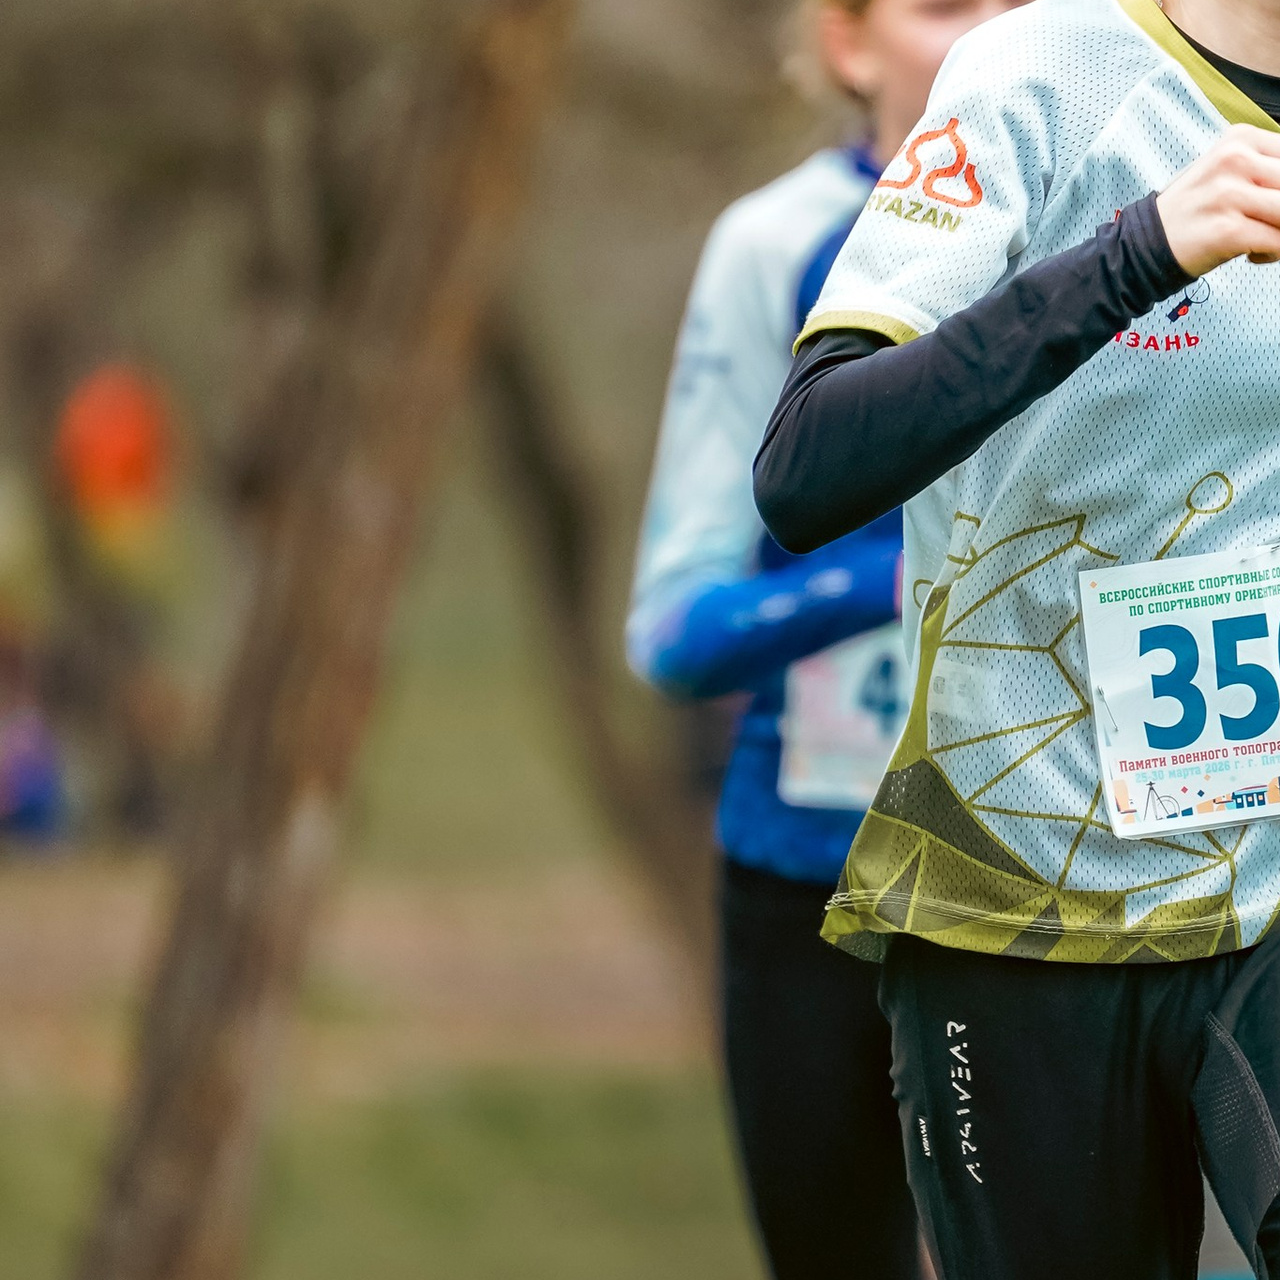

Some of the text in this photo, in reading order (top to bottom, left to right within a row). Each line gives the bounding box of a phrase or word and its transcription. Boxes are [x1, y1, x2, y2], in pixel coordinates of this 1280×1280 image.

[1099, 579, 1196, 604] ВСЕРОССИЙСКИЕ
[1198, 568, 1270, 591] СПОРТИВНЫЕ
[1128, 603, 1145, 617] ПО
[1147, 590, 1231, 614] СПОРТИВНОМУ
[1118, 755, 1168, 773] Памяти
[1170, 748, 1229, 766] военного
[1168, 765, 1202, 779] марта
[1204, 761, 1231, 773] 2026
[945, 1020, 984, 1184] ARSWEAR
